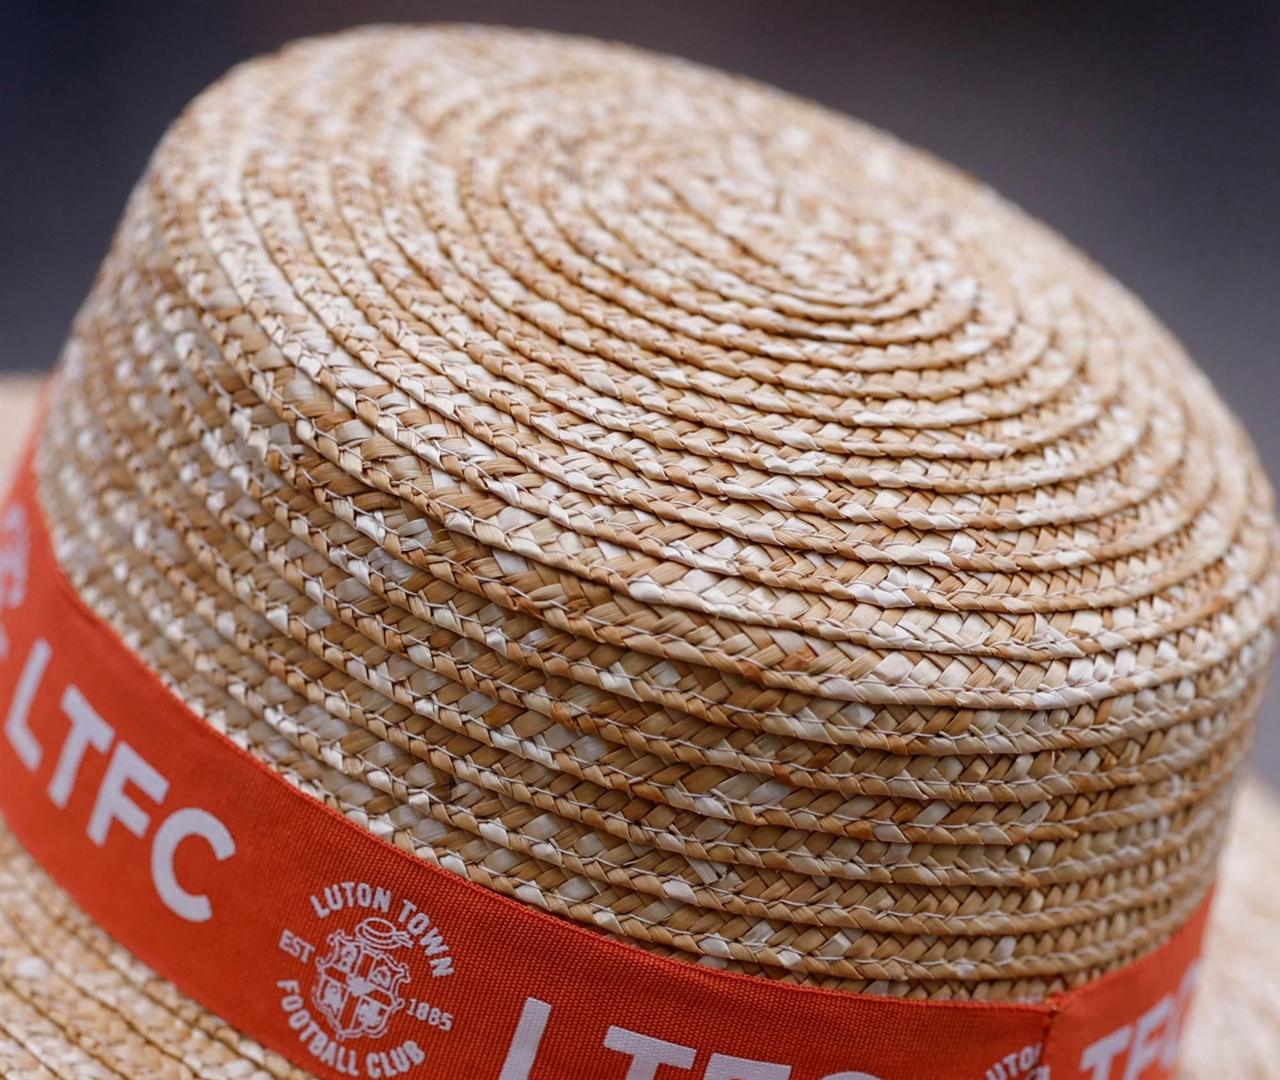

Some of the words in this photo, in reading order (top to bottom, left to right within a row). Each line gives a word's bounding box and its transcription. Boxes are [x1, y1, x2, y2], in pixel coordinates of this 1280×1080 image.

[5, 638, 236, 922] LTFC
[278, 928, 316, 964] EST
[310, 882, 393, 918] LUTON
[397, 899, 455, 977] TOWN
[276, 979, 360, 1077] FOOTBALL
[365, 1039, 426, 1079] CLUB
[407, 998, 454, 1032] 1885
